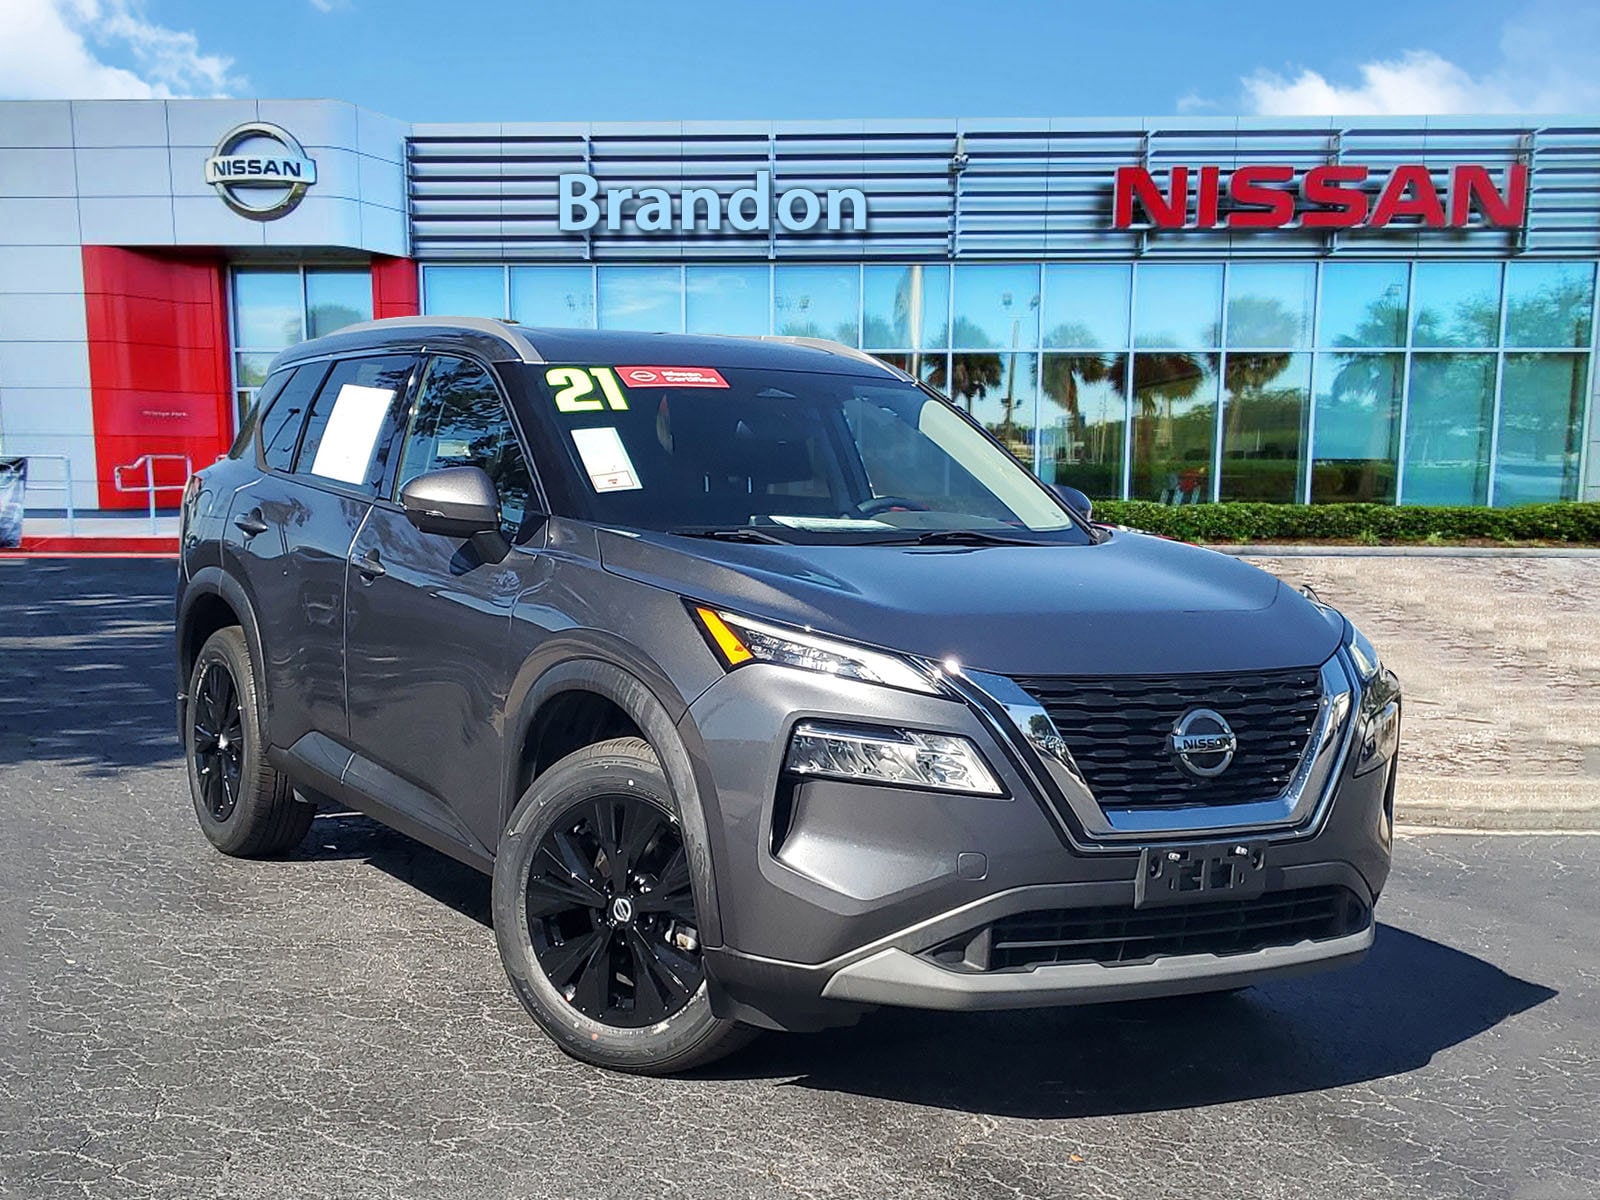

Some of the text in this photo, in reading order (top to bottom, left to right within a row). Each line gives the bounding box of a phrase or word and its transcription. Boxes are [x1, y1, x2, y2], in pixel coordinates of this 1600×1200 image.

[213, 160, 301, 177] NISSAN
[1114, 165, 1528, 228] NISSAN
[545, 367, 629, 412] 21
[1183, 738, 1230, 750] NISSAN
